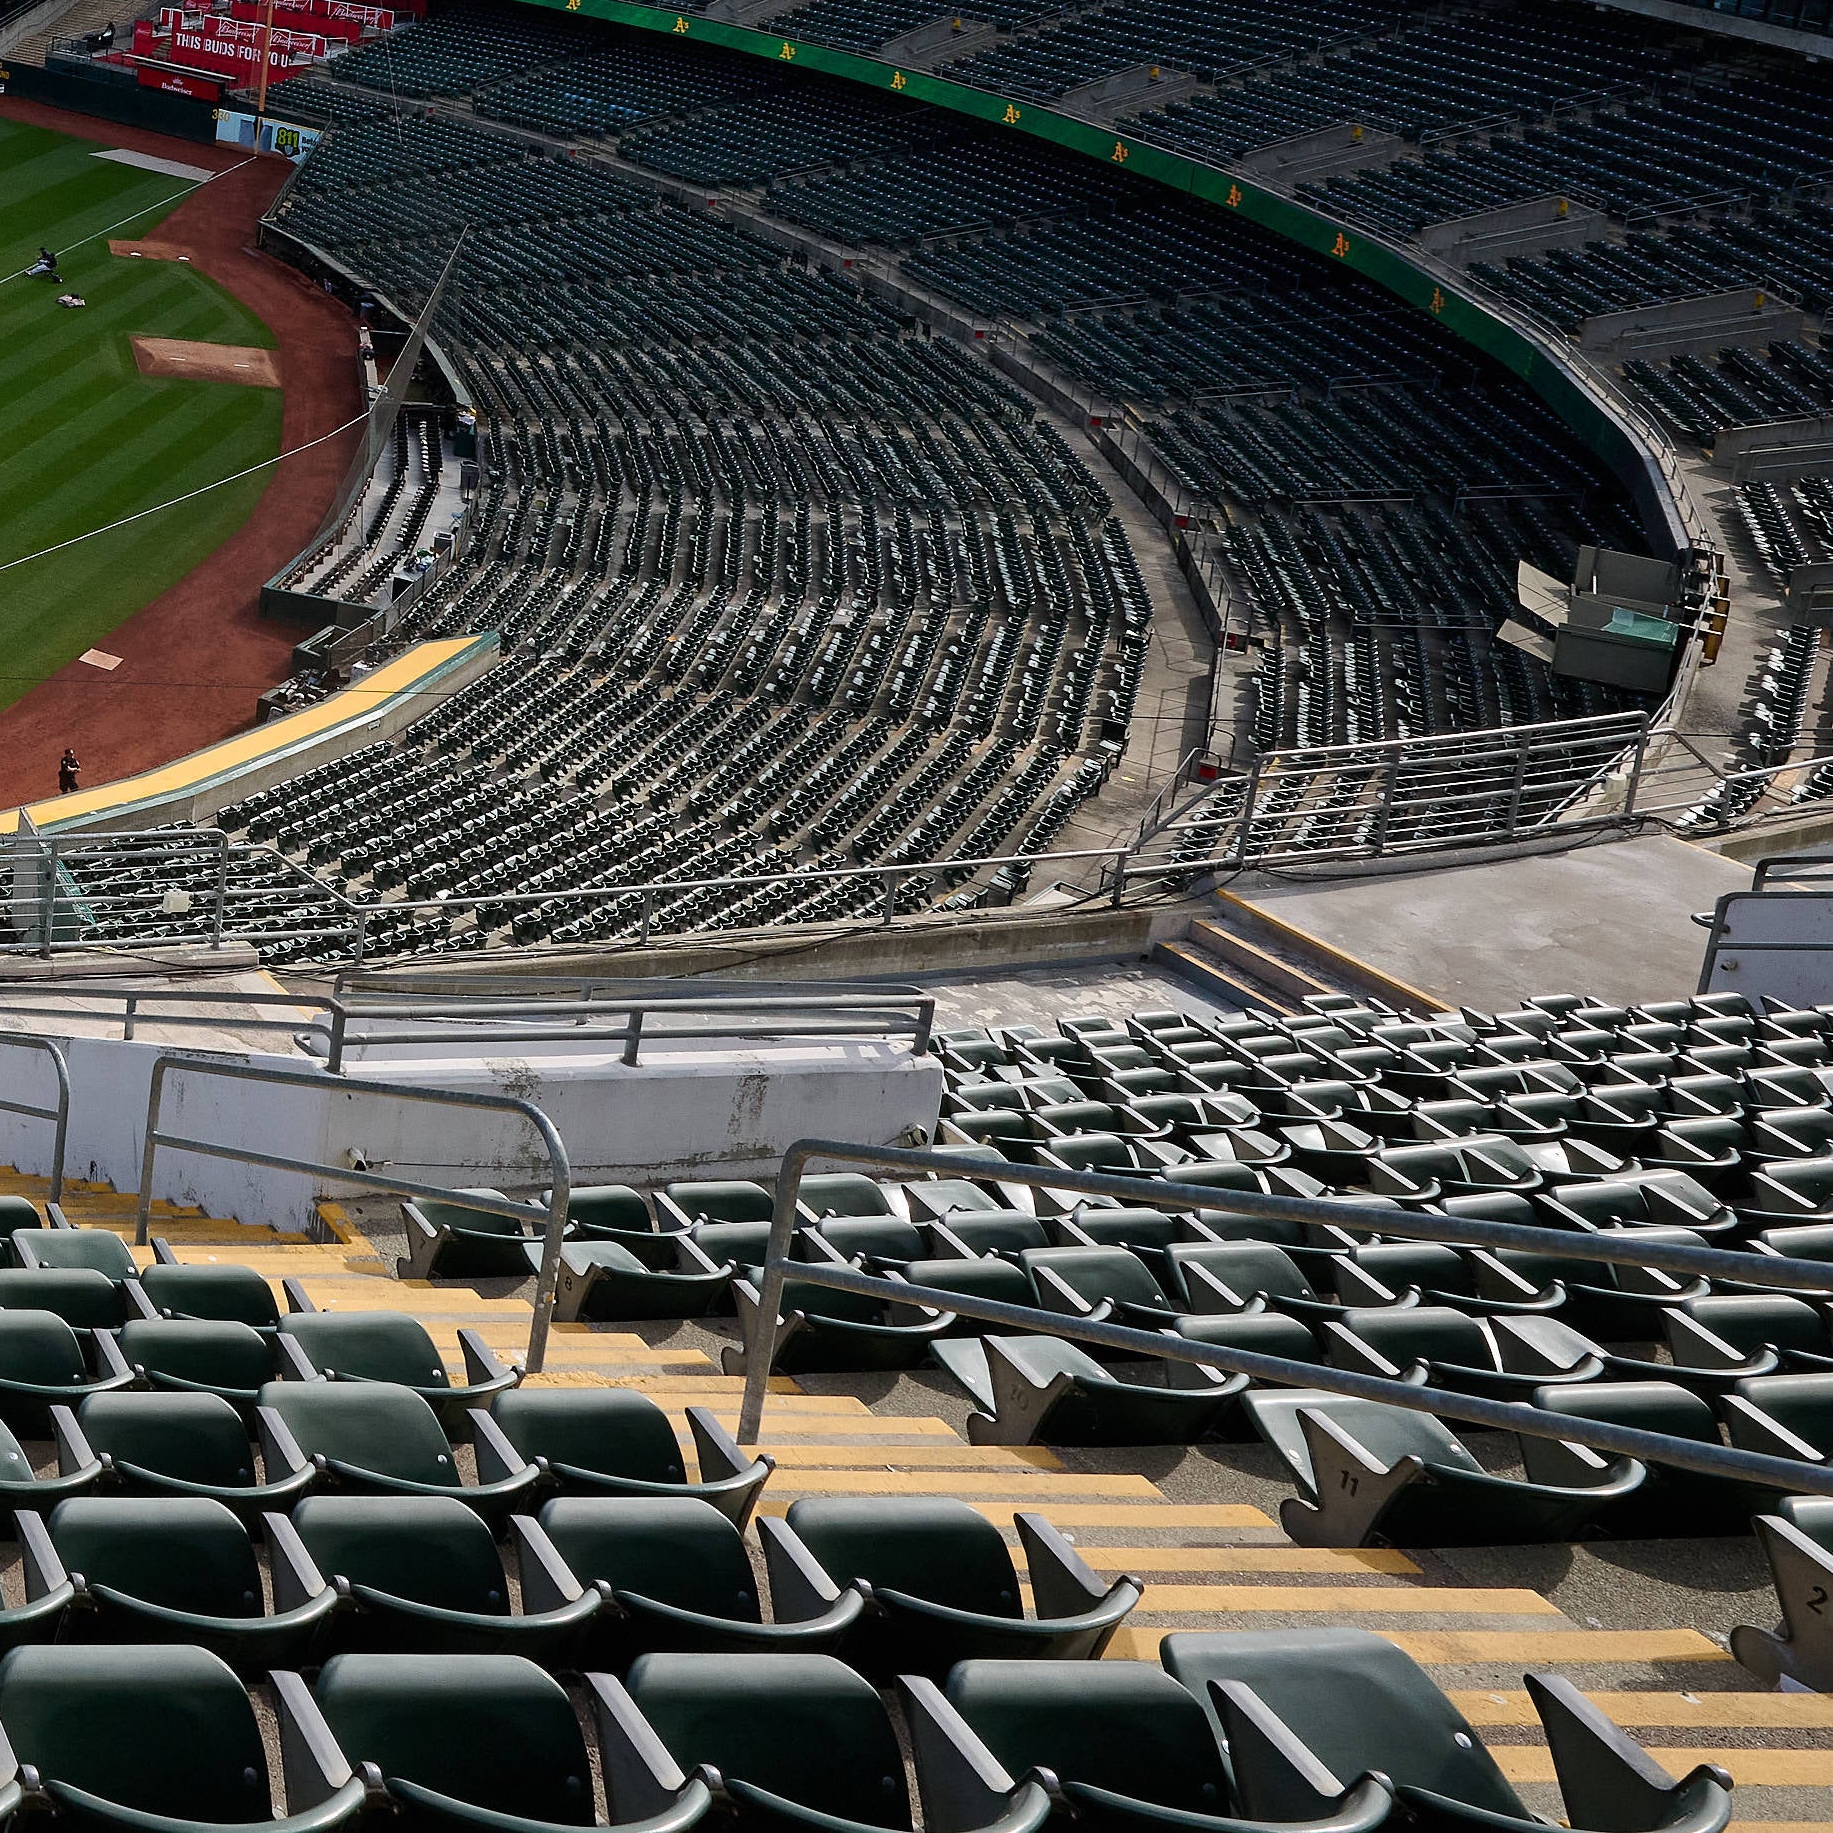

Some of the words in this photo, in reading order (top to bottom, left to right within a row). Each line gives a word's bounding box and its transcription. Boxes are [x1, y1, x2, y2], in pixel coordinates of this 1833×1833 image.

[175, 32, 201, 50] THIS
[237, 44, 261, 63] FOR
[161, 82, 193, 96] Budweiser
[278, 128, 299, 148] 811
